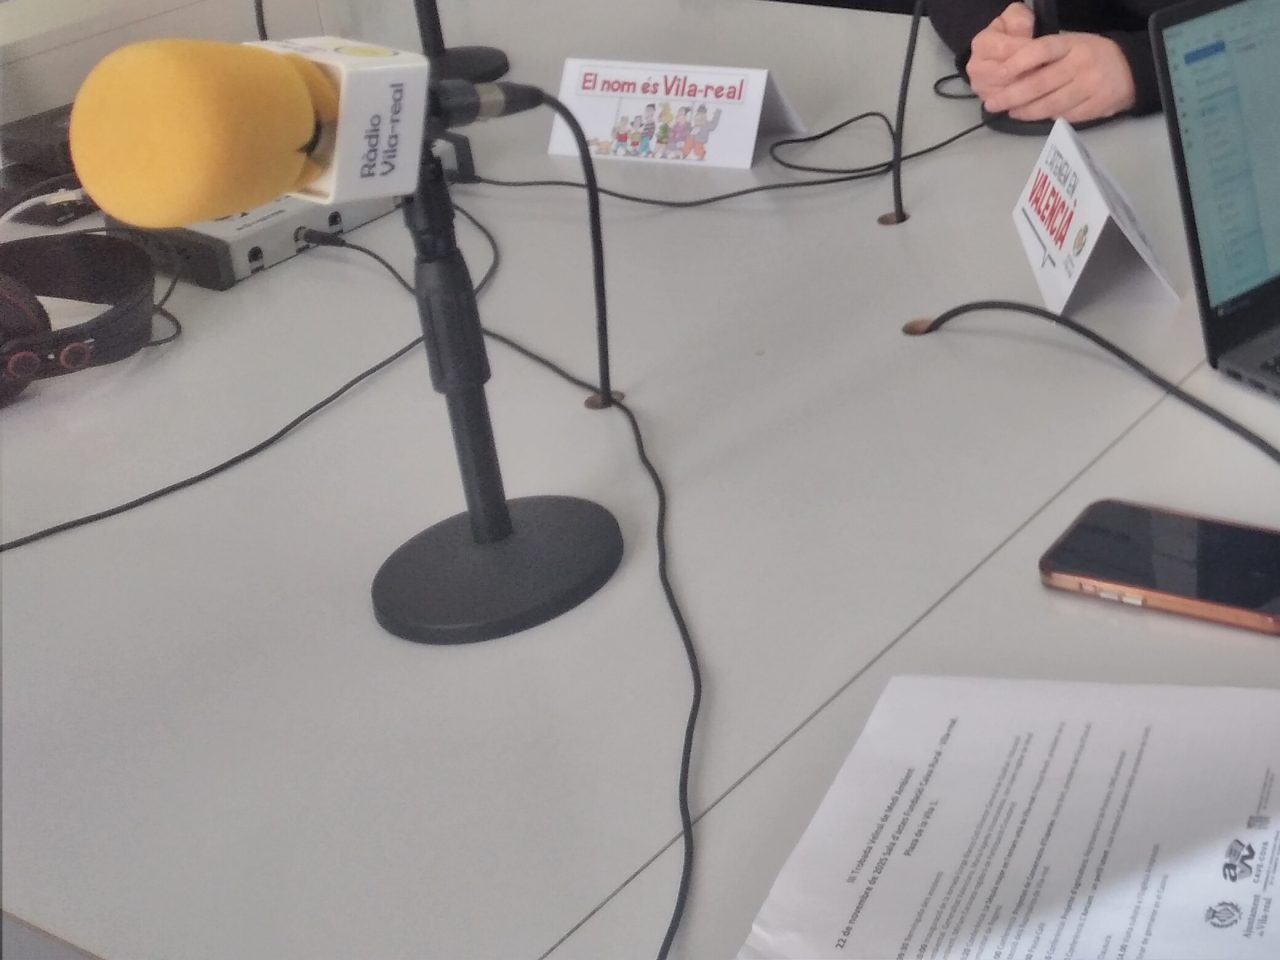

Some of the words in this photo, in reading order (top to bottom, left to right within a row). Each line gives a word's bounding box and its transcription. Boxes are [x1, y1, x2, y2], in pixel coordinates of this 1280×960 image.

[581, 72, 597, 90] El
[601, 78, 636, 93] nom
[663, 74, 744, 100] Vila-real
[360, 114, 382, 178] Ràdio
[380, 83, 404, 177] Vila-real
[1028, 167, 1077, 251] VALENCIÀ
[840, 925, 852, 936] de
[846, 886, 872, 923] novembre
